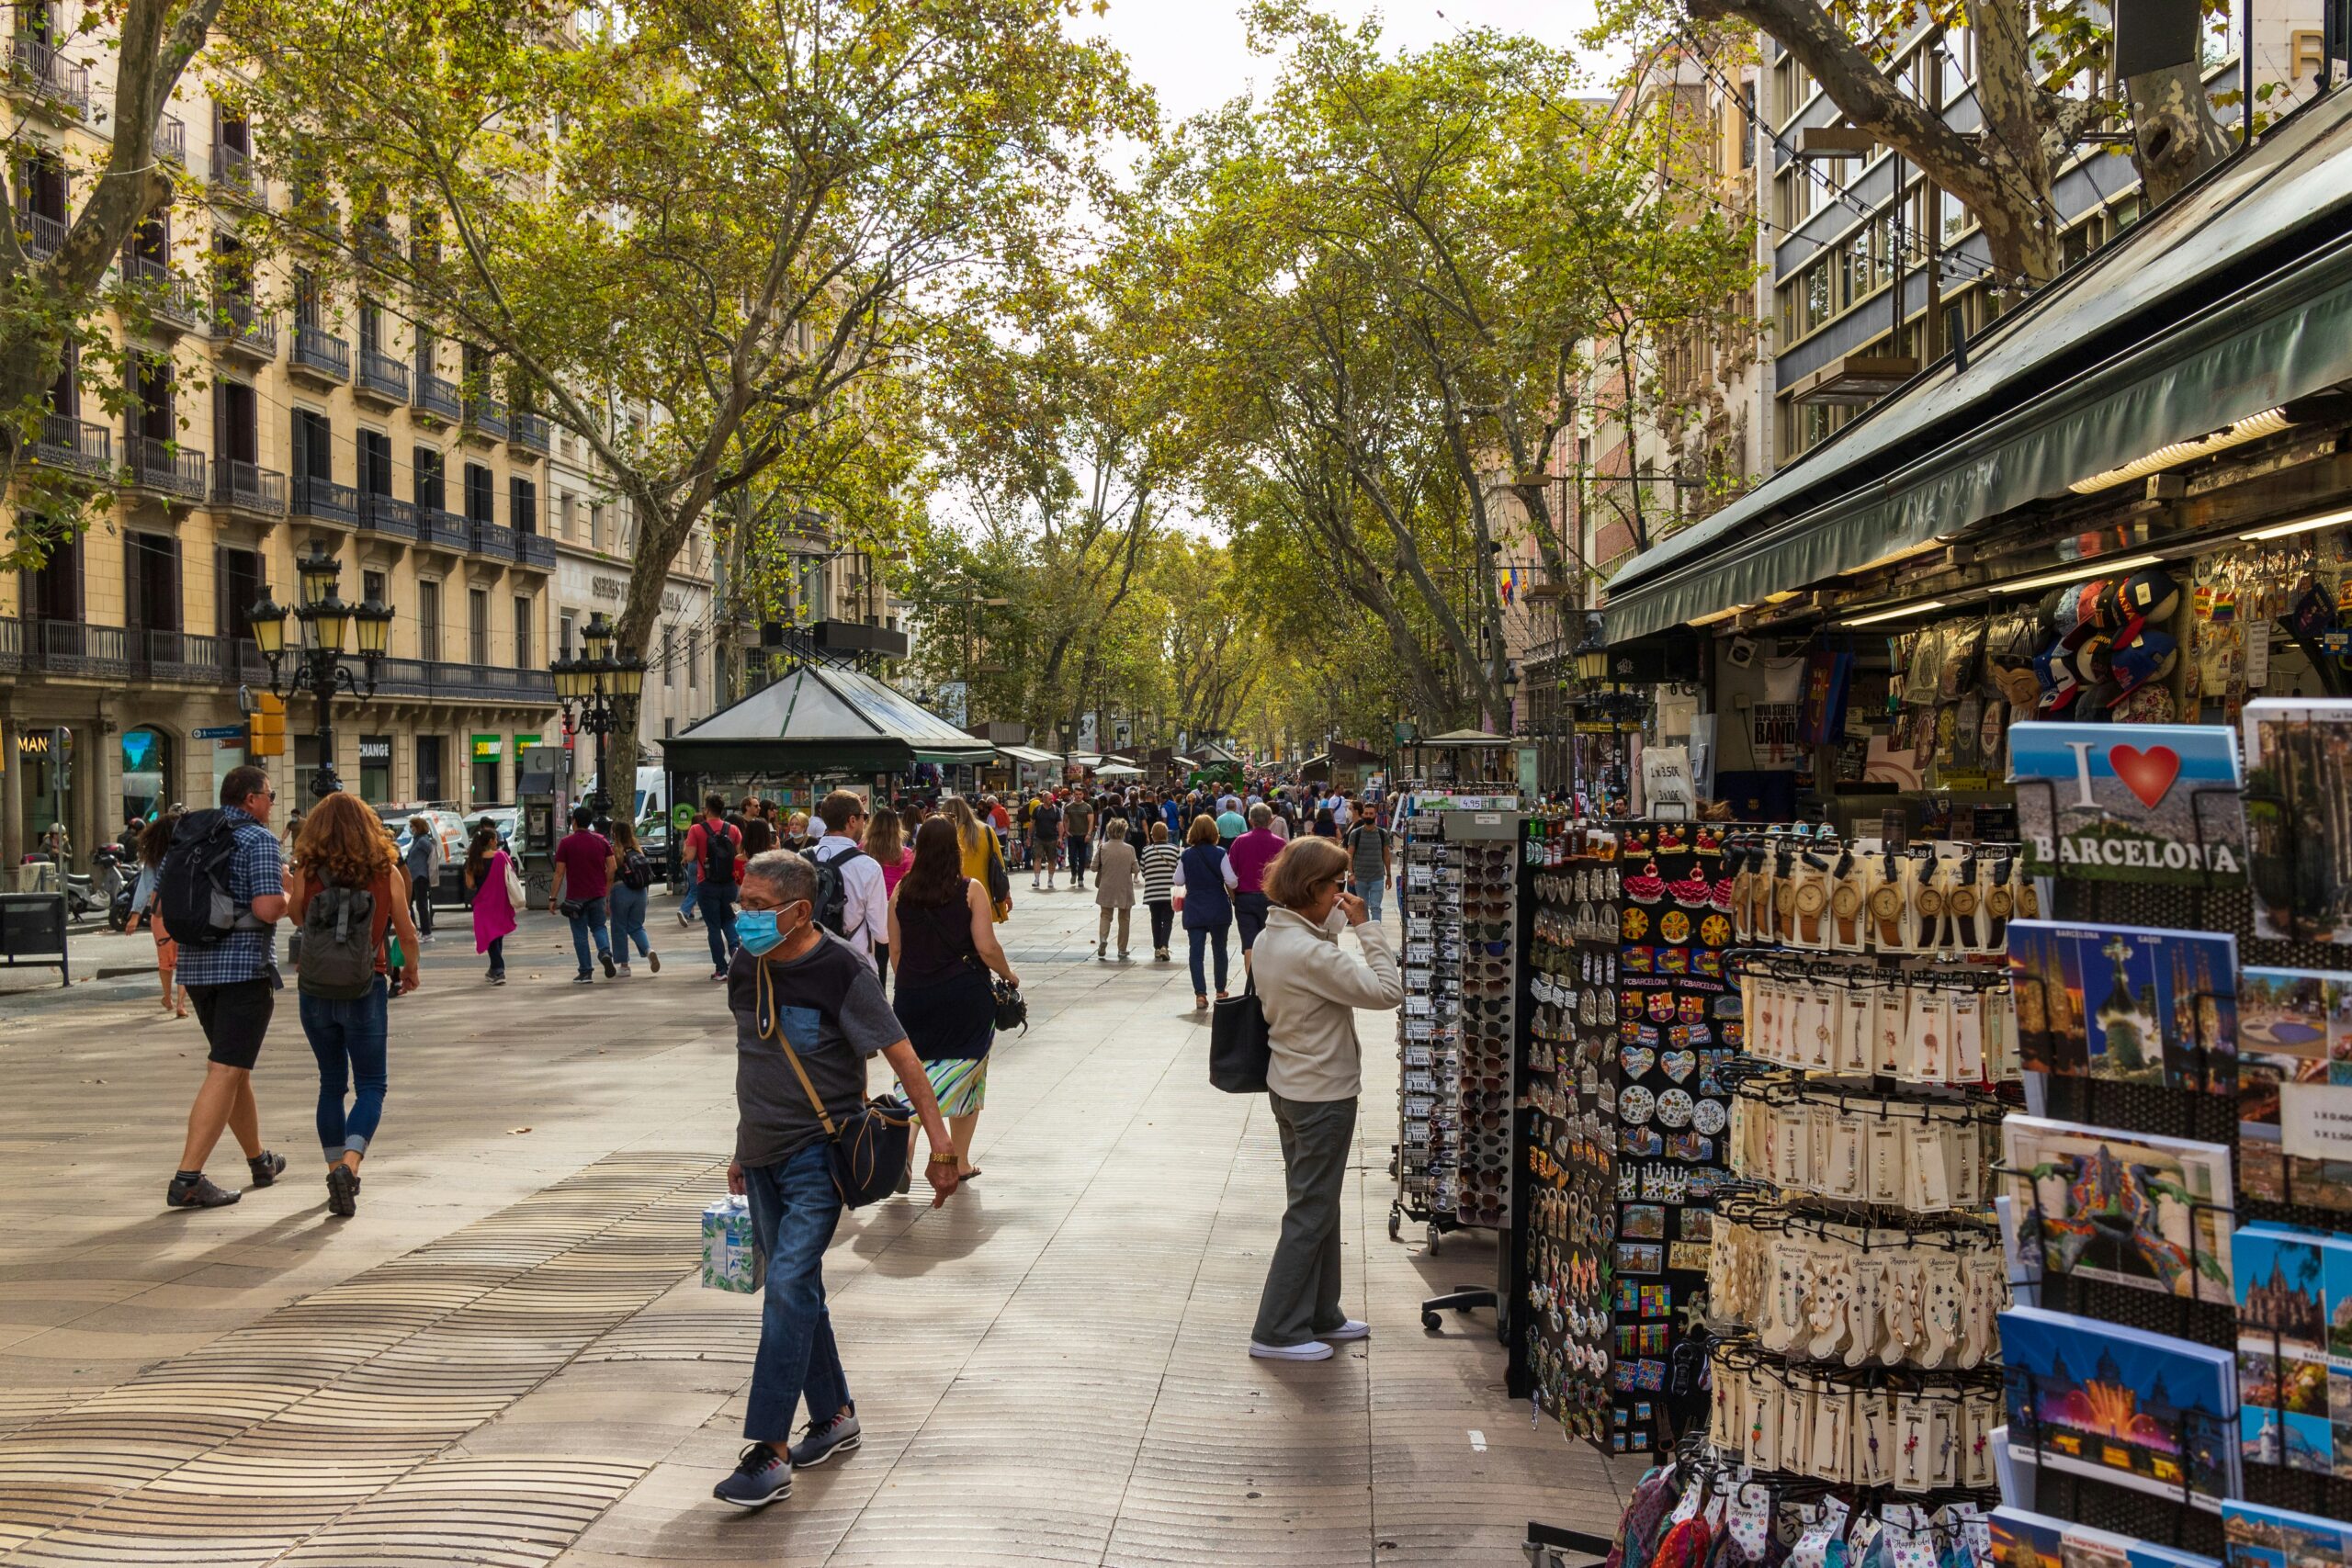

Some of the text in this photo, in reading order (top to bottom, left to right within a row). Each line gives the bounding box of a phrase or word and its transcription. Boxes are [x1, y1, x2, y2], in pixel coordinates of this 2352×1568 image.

[1772, 705, 1795, 716] STREET
[1755, 722, 1795, 744] BAND
[17, 736, 50, 752] MAN
[475, 741, 503, 755] SUBWAY
[2064, 741, 2104, 808] I
[1463, 799, 1480, 808] 4.95
[2033, 838, 2240, 874] BARCELONA
[2055, 929, 2100, 939] BARCELONA
[1776, 1243, 1806, 1253] Barcelona
[1810, 1251, 1830, 1260] Happy
[1852, 1258, 1883, 1267] Barcelona
[1889, 1257, 1908, 1266] Happy
[1928, 1258, 1956, 1266] Barcelona
[1969, 1260, 1996, 1269] Barcelona
[1747, 1383, 1771, 1394] Barcelona
[1821, 1393, 1846, 1404] Barcelona
[1860, 1400, 1883, 1411] Barcelona
[1900, 1403, 1928, 1413] Barcelona
[1931, 1401, 1956, 1409] Barcelona
[1967, 1402, 1990, 1410] Barcelona
[1731, 1506, 1767, 1518] Happy Art
[1892, 1537, 1930, 1549] Happy Art
